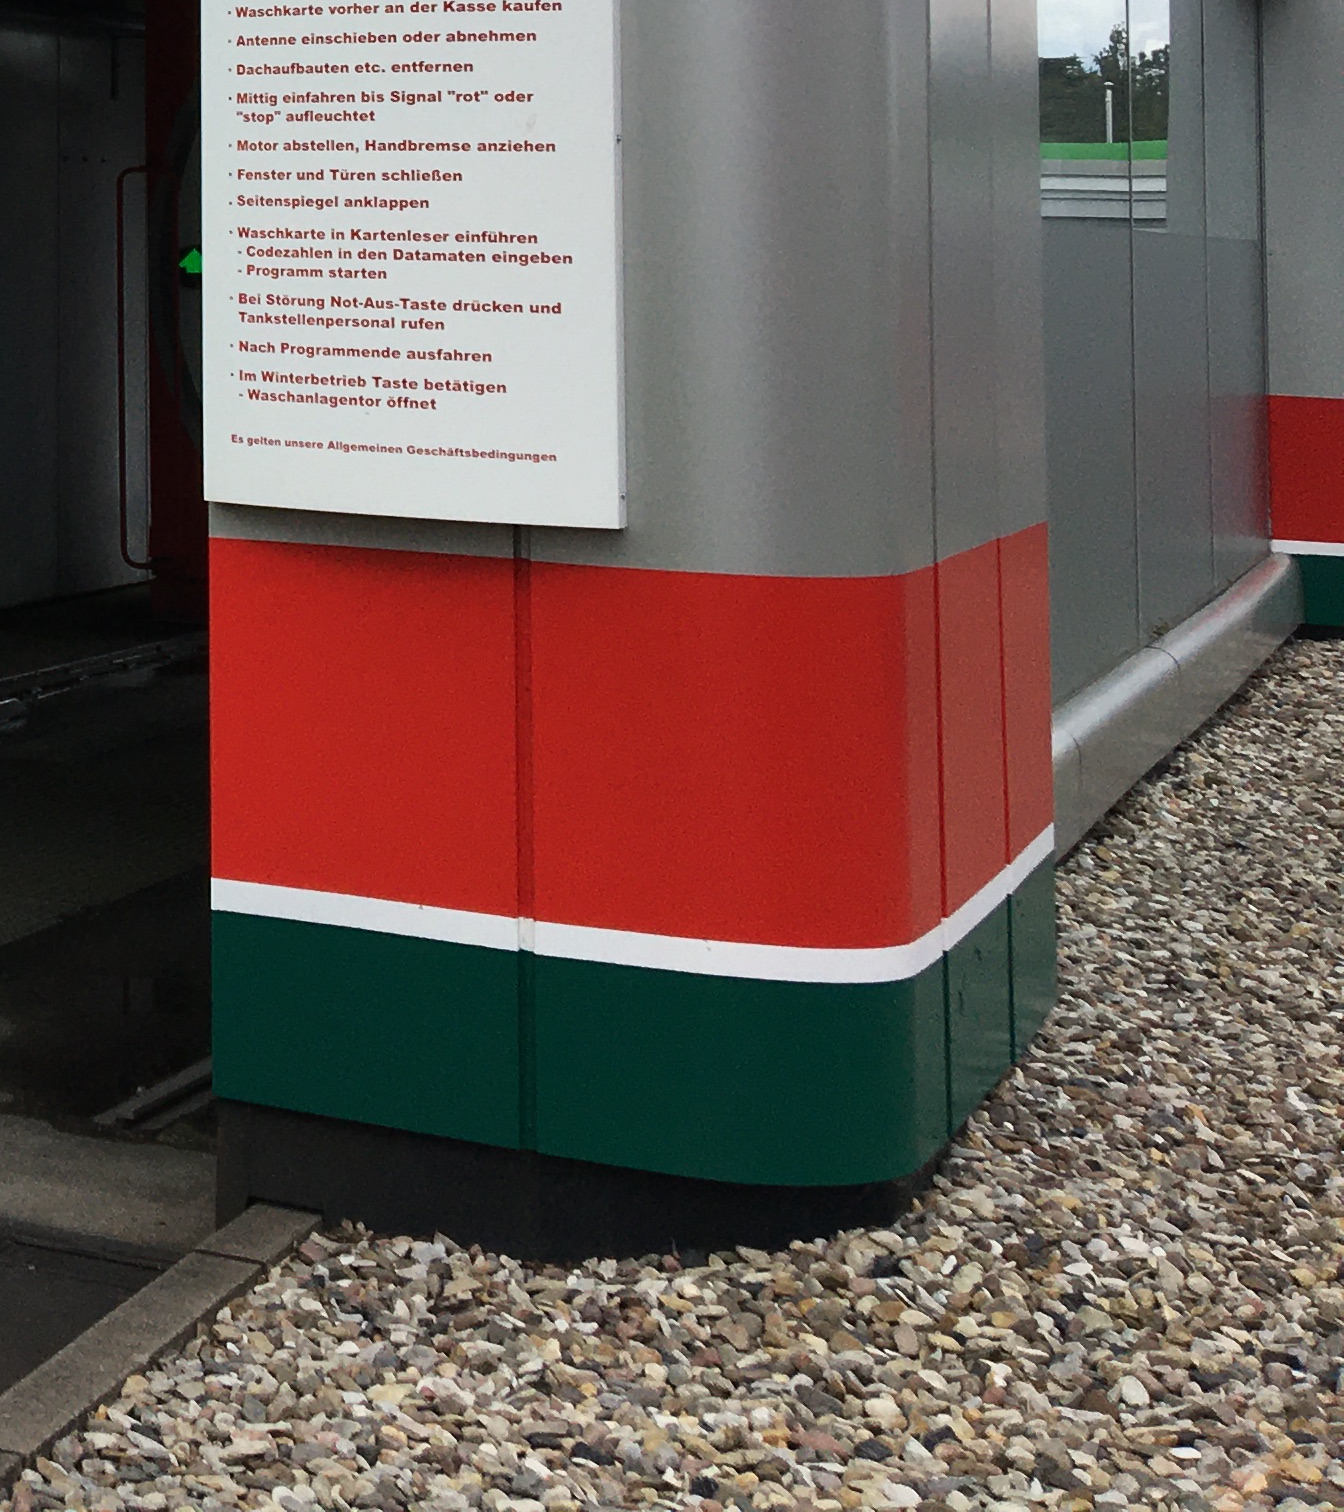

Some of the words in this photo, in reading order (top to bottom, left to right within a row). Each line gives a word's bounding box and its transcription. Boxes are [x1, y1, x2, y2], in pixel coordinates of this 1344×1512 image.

[235, 4, 324, 18] Waschkarte
[328, 2, 379, 14] vorher
[385, 4, 404, 14] an
[410, 1, 437, 13] der
[443, 0, 496, 13] Kasse
[502, 0, 563, 12] kaufen
[236, 35, 297, 47] Antenne
[301, 31, 398, 45] einschieben
[403, 30, 441, 43] oder
[446, 29, 537, 42] abnehmen
[236, 62, 350, 76] Dachaufbauten
[355, 61, 386, 74] etc.
[391, 60, 474, 73] entfernen
[236, 92, 278, 107] Mittig
[282, 91, 356, 104] einfahren
[361, 91, 385, 103] bis
[390, 90, 442, 105] Signal
[447, 90, 489, 103] "rot"
[494, 90, 534, 103] oder
[236, 110, 282, 125] "stop"
[286, 109, 376, 123] aufleuchtet
[237, 139, 279, 152] Motor
[283, 139, 360, 153] abstellen,
[365, 139, 472, 152] Handbremse
[476, 139, 556, 153] anziehen
[237, 168, 293, 181] Fenster
[296, 168, 325, 181] und
[330, 168, 376, 181] Türen
[381, 169, 463, 182] schließen
[237, 195, 339, 210] Seitenspiegel
[343, 196, 430, 211] anklappen
[237, 227, 326, 240] Waschkarte
[330, 228, 345, 241] in
[350, 228, 450, 243] Kartenleser
[454, 230, 538, 245] einführen
[246, 245, 333, 259] Codezahlen
[338, 247, 353, 260] in
[357, 248, 388, 261] den
[392, 248, 486, 263] Datamaten
[491, 251, 573, 266] eingeben
[246, 264, 324, 279] Programm
[328, 267, 387, 280] starten
[238, 292, 261, 305] Bei
[265, 293, 325, 310] Störung
[330, 296, 447, 311] Not-Aus-Taste
[452, 299, 524, 314] drücken
[529, 302, 562, 315] und
[238, 311, 396, 330] Tankstellenpersonal
[400, 317, 445, 331] rufen
[238, 340, 276, 354] Nach
[280, 342, 401, 359] Programmende
[406, 348, 492, 363] ausfahren
[239, 369, 257, 382] Im
[261, 370, 367, 388] Winterbetrieb
[372, 376, 419, 390] Taste
[424, 378, 507, 395] betätigen
[247, 388, 382, 408] Waschanlagentor
[386, 396, 437, 410] öffnet
[231, 433, 244, 445] Es
[246, 435, 282, 449] gelten
[284, 440, 324, 451] unsere
[327, 440, 403, 455] Allgemeinen
[406, 445, 557, 463] Geschäftsbedingungen
